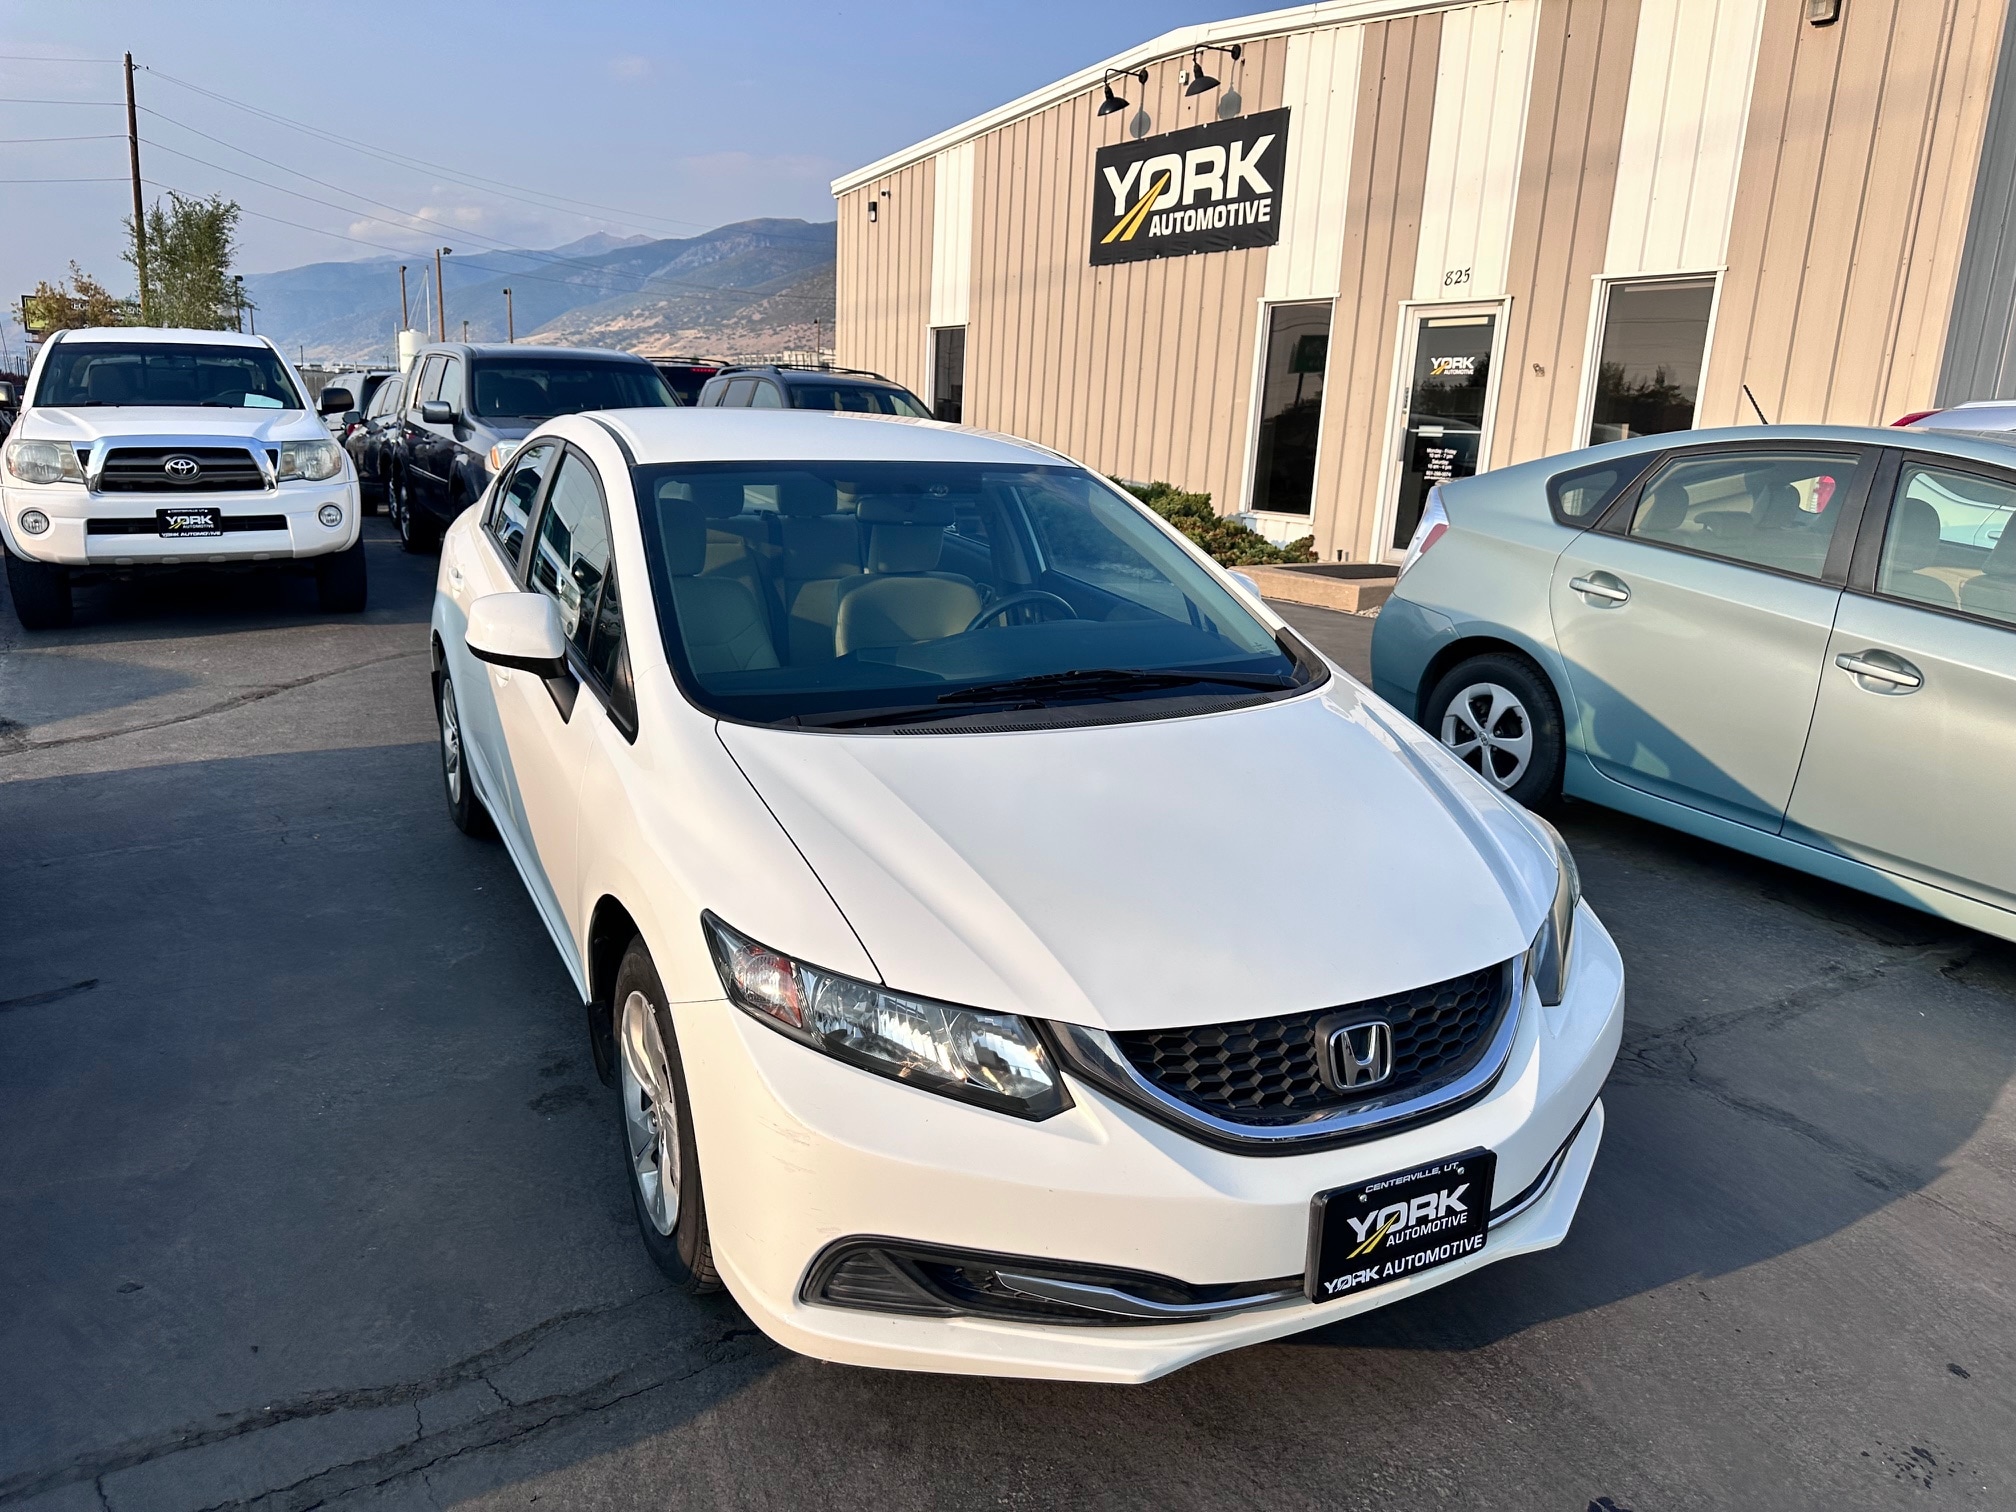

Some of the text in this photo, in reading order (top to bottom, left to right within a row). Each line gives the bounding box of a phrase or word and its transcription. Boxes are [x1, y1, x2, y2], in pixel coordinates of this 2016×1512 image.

[1102, 133, 1276, 217] YORK
[1148, 198, 1272, 238] AUTOMOTIVE
[1444, 267, 1471, 286] 825
[1430, 356, 1475, 369] YORK
[165, 515, 213, 525] YORK
[1365, 1161, 1460, 1193] CENTERVILLE, UT
[1346, 1183, 1471, 1244] YORK
[1386, 1212, 1468, 1247] AUTOMOTIVE
[1324, 1234, 1484, 1294] YORK AUTOMOTIVE
